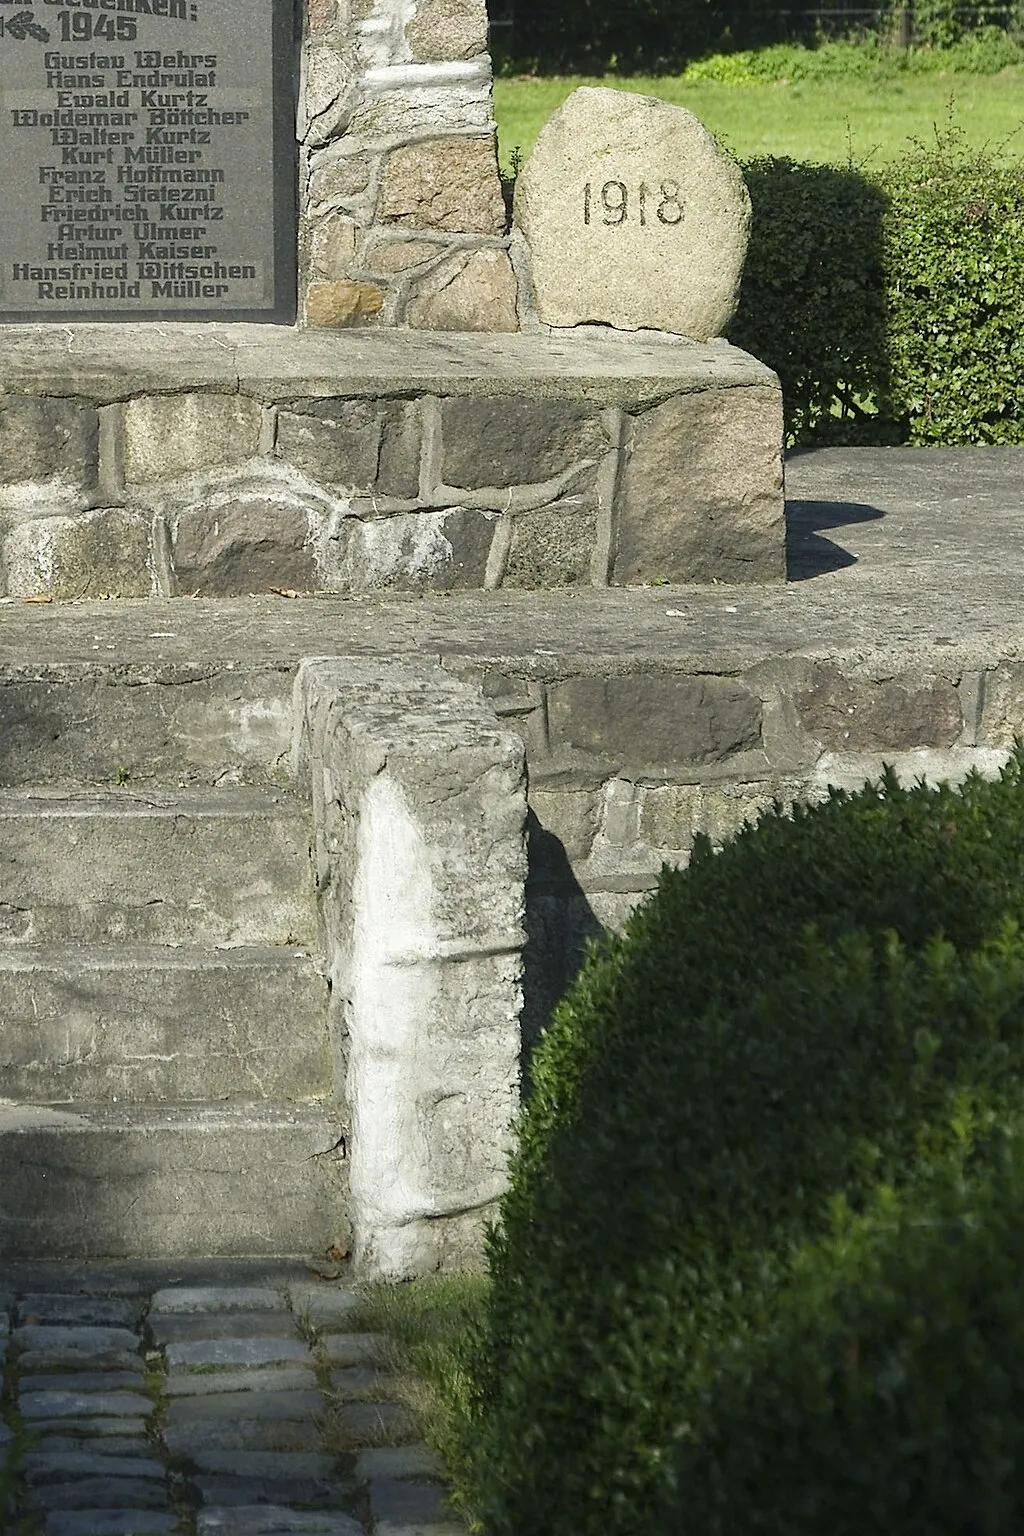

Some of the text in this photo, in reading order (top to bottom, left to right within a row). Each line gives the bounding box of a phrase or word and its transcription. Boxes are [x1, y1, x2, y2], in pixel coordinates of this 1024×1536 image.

[57, 11, 137, 42] 1945
[44, 51, 217, 69] Gustav Wehrs
[47, 71, 216, 88] Hans Endrulat
[57, 91, 207, 108] Ewald Kurtz
[11, 109, 249, 127] Woldemar Böttcher
[50, 127, 210, 146] Walter Kurtz
[61, 147, 201, 164] Kurt Müller
[39, 166, 224, 184] Franz Hoffmann
[49, 186, 112, 203] Erich
[584, 180, 684, 226] 1918
[41, 205, 223, 222] Friedrich Kurtz
[58, 224, 122, 241] Artur
[47, 243, 217, 261] Helmut Kaiser
[13, 263, 255, 281] Hansfried Wittschen
[38, 281, 229, 299] Reinhold Müller
